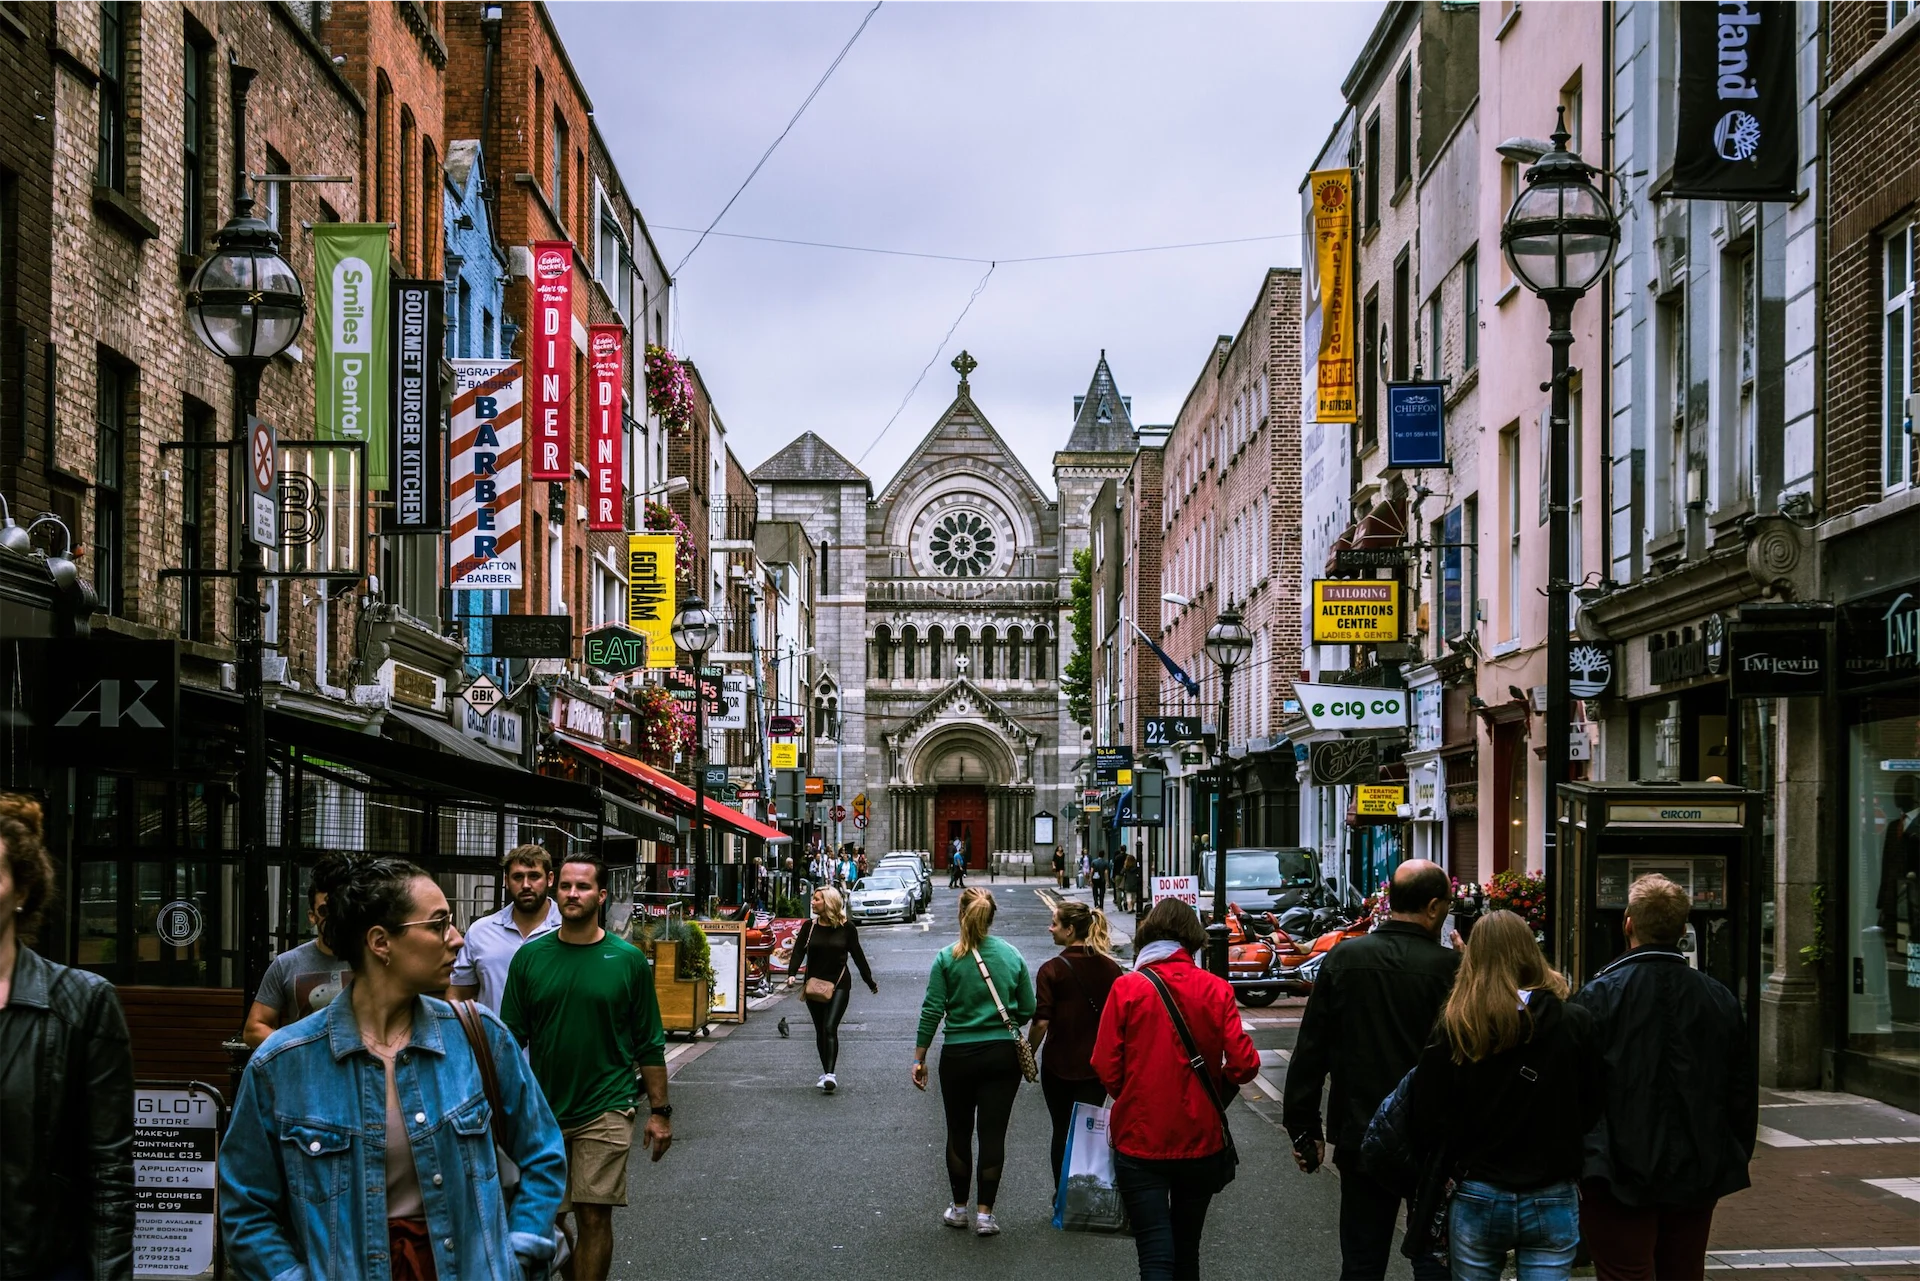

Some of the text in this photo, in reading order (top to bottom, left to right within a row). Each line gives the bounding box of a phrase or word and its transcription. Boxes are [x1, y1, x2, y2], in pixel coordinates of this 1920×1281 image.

[1331, 241, 1342, 354] ALTERATION
[342, 270, 365, 345] Smiles
[466, 367, 518, 377] GRAFTON
[1320, 362, 1352, 384] CENTRE
[468, 380, 513, 390] BARBER
[542, 308, 560, 471] DINER
[341, 358, 363, 437] Dental
[402, 289, 423, 524] GOURMET BURGER KITCHEN
[1394, 404, 1437, 413] CHIFFON
[598, 382, 614, 522] DINER
[473, 396, 500, 559] BARBER
[464, 561, 517, 571] GRAFTON
[467, 574, 512, 583] BARBER
[631, 552, 669, 621] GOTHAM
[1327, 588, 1388, 599] TAILORING
[1322, 604, 1394, 616] ALTERATIONS
[499, 622, 565, 634] GRAFTON
[1337, 618, 1378, 629] CENTRE
[1321, 631, 1393, 639] LADIES & GENTS
[503, 637, 561, 649] BARBER
[588, 636, 642, 665] EAT
[694, 667, 722, 677] INES
[669, 667, 718, 699] KEHES
[471, 689, 494, 702] GBK
[1311, 702, 1326, 717] e
[829, 810, 846, 818] SOP
[1122, 807, 1131, 819] 2
[1160, 878, 1189, 890] DO NOT
[171, 911, 190, 938] B
[138, 1098, 208, 1114] GLOT
[152, 1118, 190, 1126] STORE
[139, 1164, 204, 1173] APPLICATION
[156, 1191, 203, 1200] COURSES
